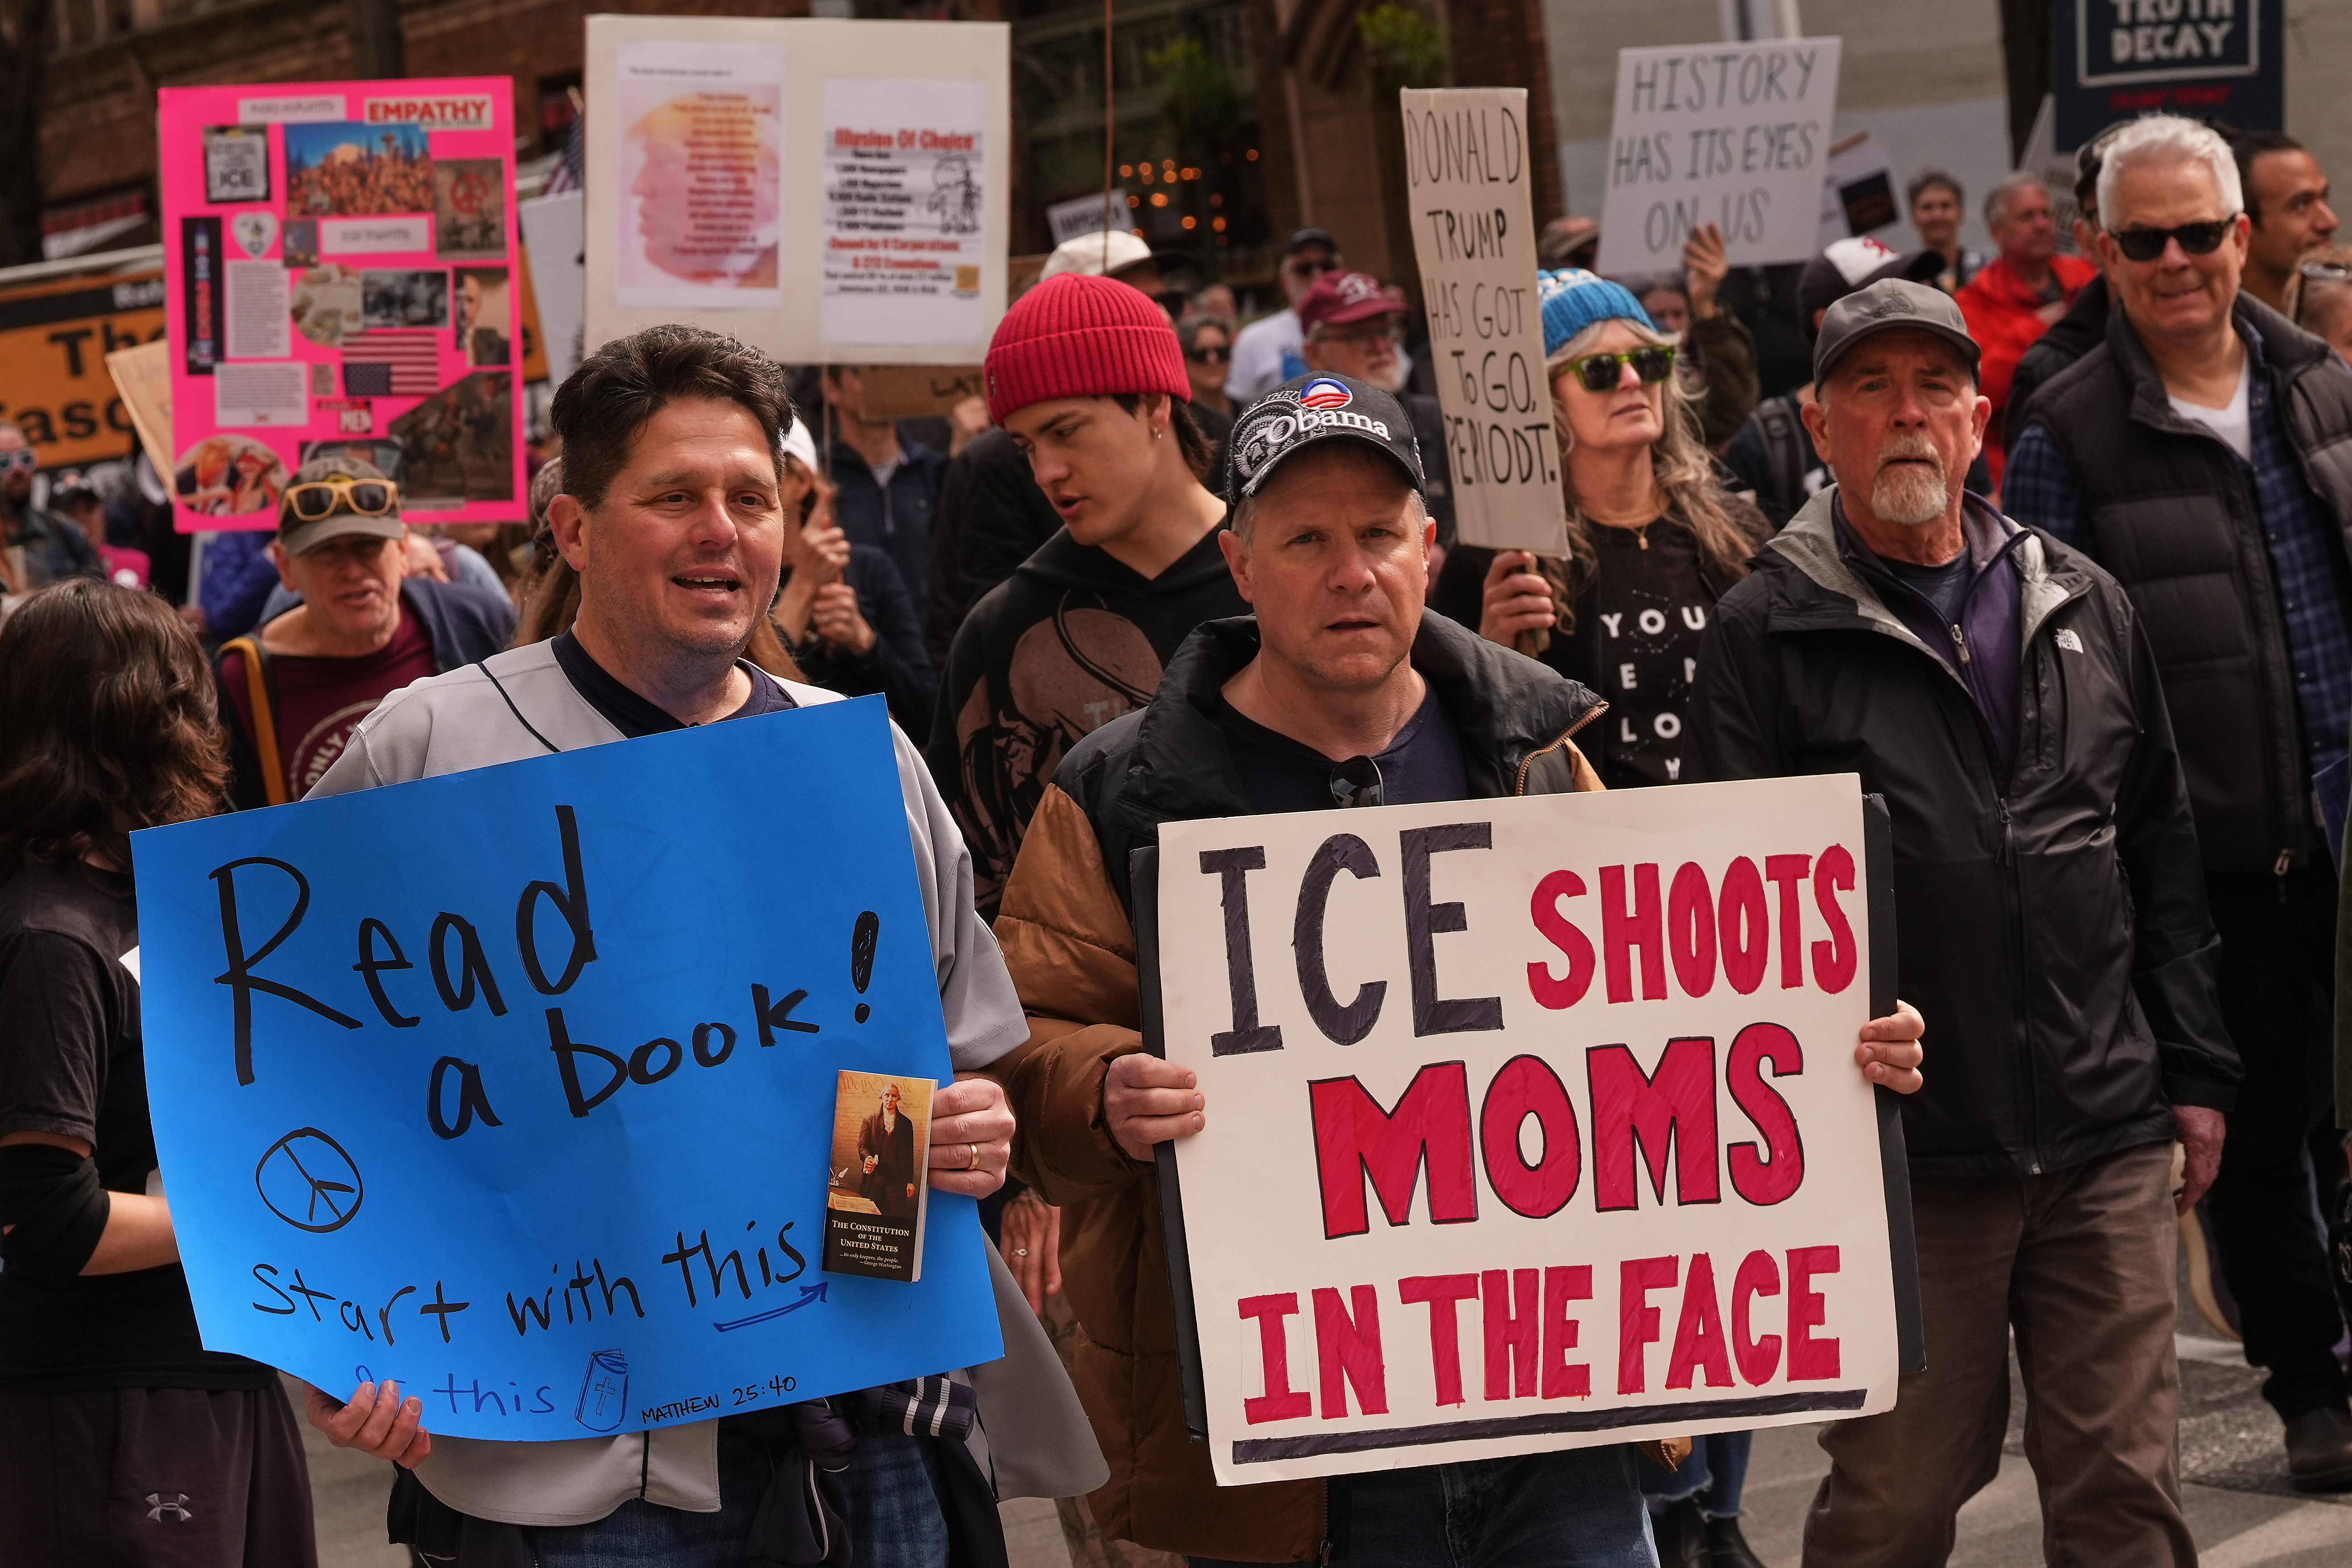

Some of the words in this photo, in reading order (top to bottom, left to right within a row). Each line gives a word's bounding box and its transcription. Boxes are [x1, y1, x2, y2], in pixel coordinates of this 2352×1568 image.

[2111, 21, 2232, 63] DECAY
[369, 100, 487, 121] EMPATHY
[1632, 47, 1817, 113] HISTORY
[220, 169, 254, 187] ICE
[1406, 107, 1521, 188] DONALD
[1613, 130, 1673, 188] HAS
[1685, 127, 1736, 178] ITS
[1743, 120, 1820, 173] EYES
[1426, 207, 1507, 261] TRUMP
[1644, 194, 1699, 254] ON
[1721, 186, 1771, 245] US
[1427, 278, 1462, 340] HAS
[1473, 282, 1526, 339] GOT
[48, 323, 164, 377] Th
[1482, 351, 1536, 413] GO,
[1266, 409, 1392, 445] Obama
[1445, 414, 1557, 485] PERIODT.
[1600, 606, 1706, 638] YOU
[304, 731, 345, 786] ONLY
[208, 804, 599, 1086] Read
[1199, 822, 1505, 1057] ICE
[1528, 843, 1857, 1010] SHOOTS
[427, 1056, 503, 1140] a
[545, 911, 879, 1118] book!
[1307, 1022, 1805, 1240] MOMS
[832, 1220, 849, 1229] THE
[850, 1222, 910, 1237] CONSTITUTION
[840, 1239, 870, 1249] UNITED
[871, 1243, 898, 1253] STATES
[253, 1264, 470, 1346] Start
[506, 1258, 645, 1336] with
[662, 1221, 806, 1308] this
[1238, 1285, 1389, 1425] IN
[1398, 1265, 1593, 1408] THE
[1617, 1245, 1840, 1395] FACE
[433, 1373, 555, 1416] this
[642, 1394, 719, 1424] MATTHEW
[732, 1375, 797, 1407] 25:40
